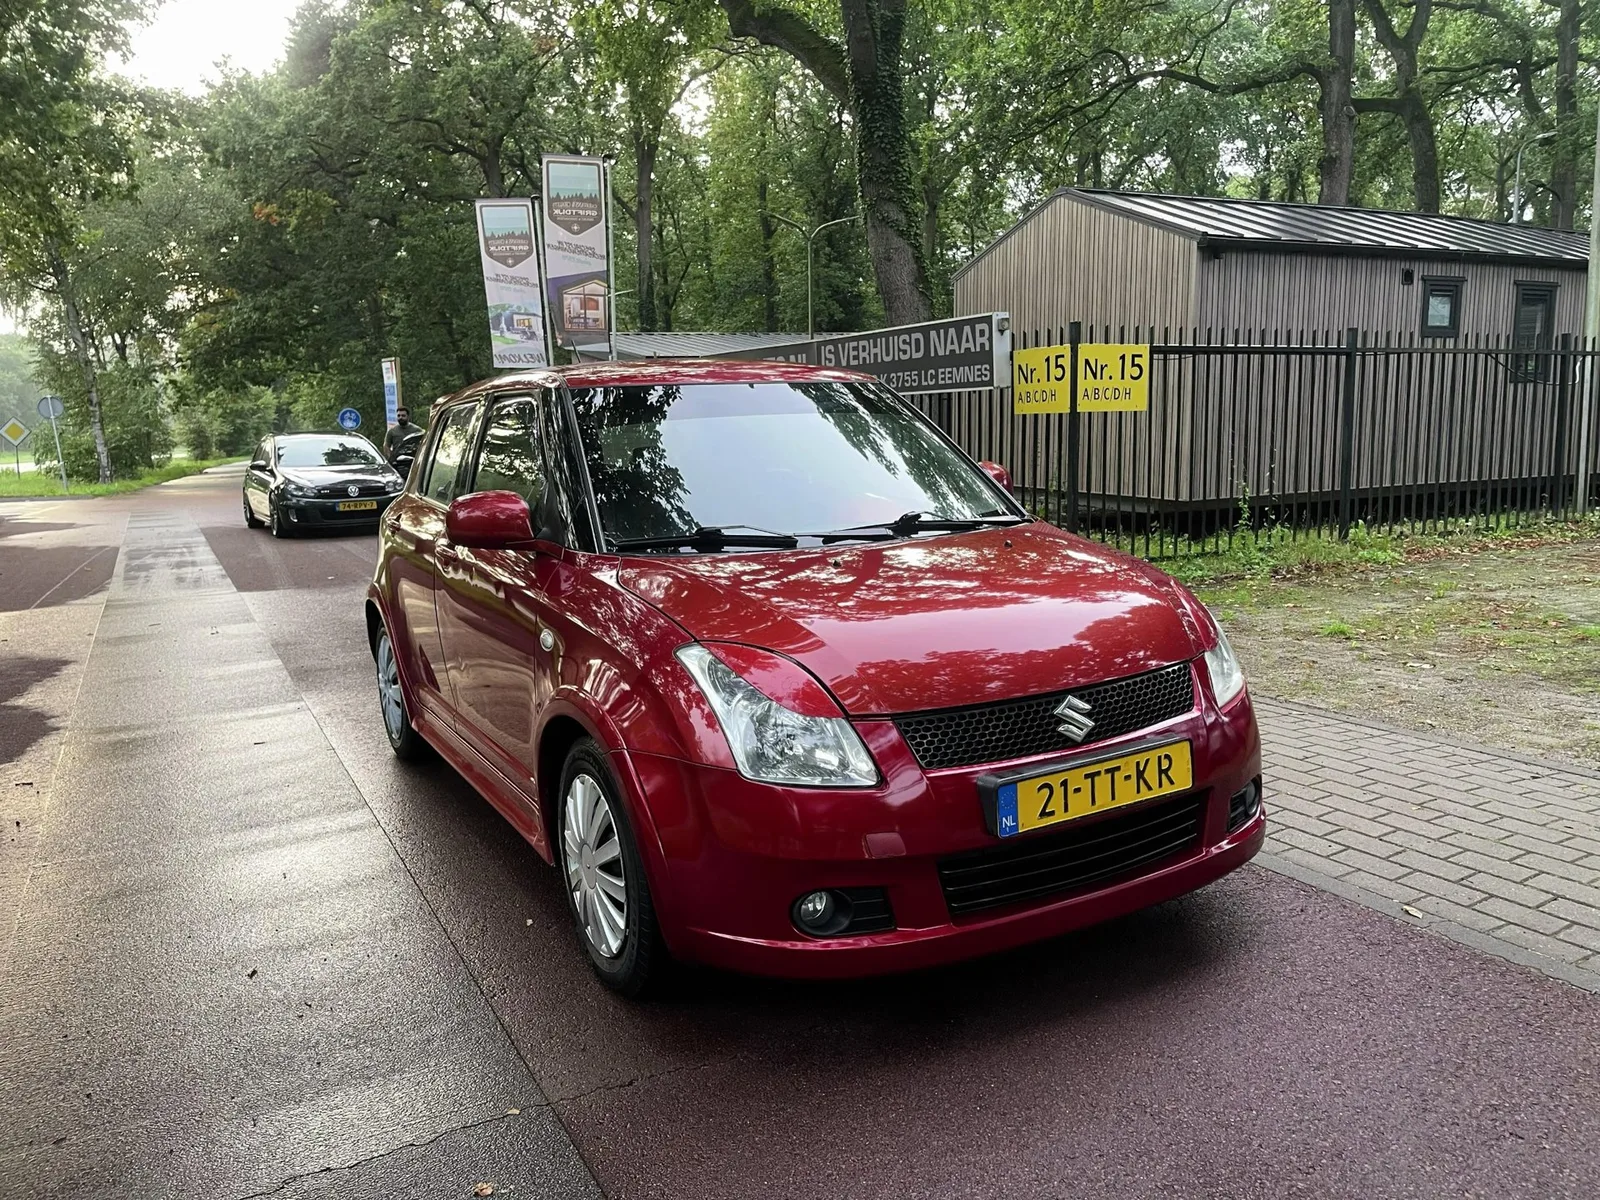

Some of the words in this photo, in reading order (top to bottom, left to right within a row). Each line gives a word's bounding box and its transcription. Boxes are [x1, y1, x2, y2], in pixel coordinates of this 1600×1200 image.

[821, 345, 835, 367] IS
[838, 332, 925, 367] VERHUISD
[929, 322, 990, 357] NAAR
[889, 371, 919, 388] 3755
[921, 368, 936, 386] LC
[938, 364, 990, 384] EEMNES
[1018, 363, 1041, 385] Nr.
[1044, 354, 1066, 382] 15
[1083, 358, 1113, 380] Nr.
[1118, 353, 1144, 380] 15
[1082, 386, 1132, 402] A/B/C/D/H
[1036, 752, 1175, 820] 21-TT-KR
[1002, 814, 1017, 829] NL
